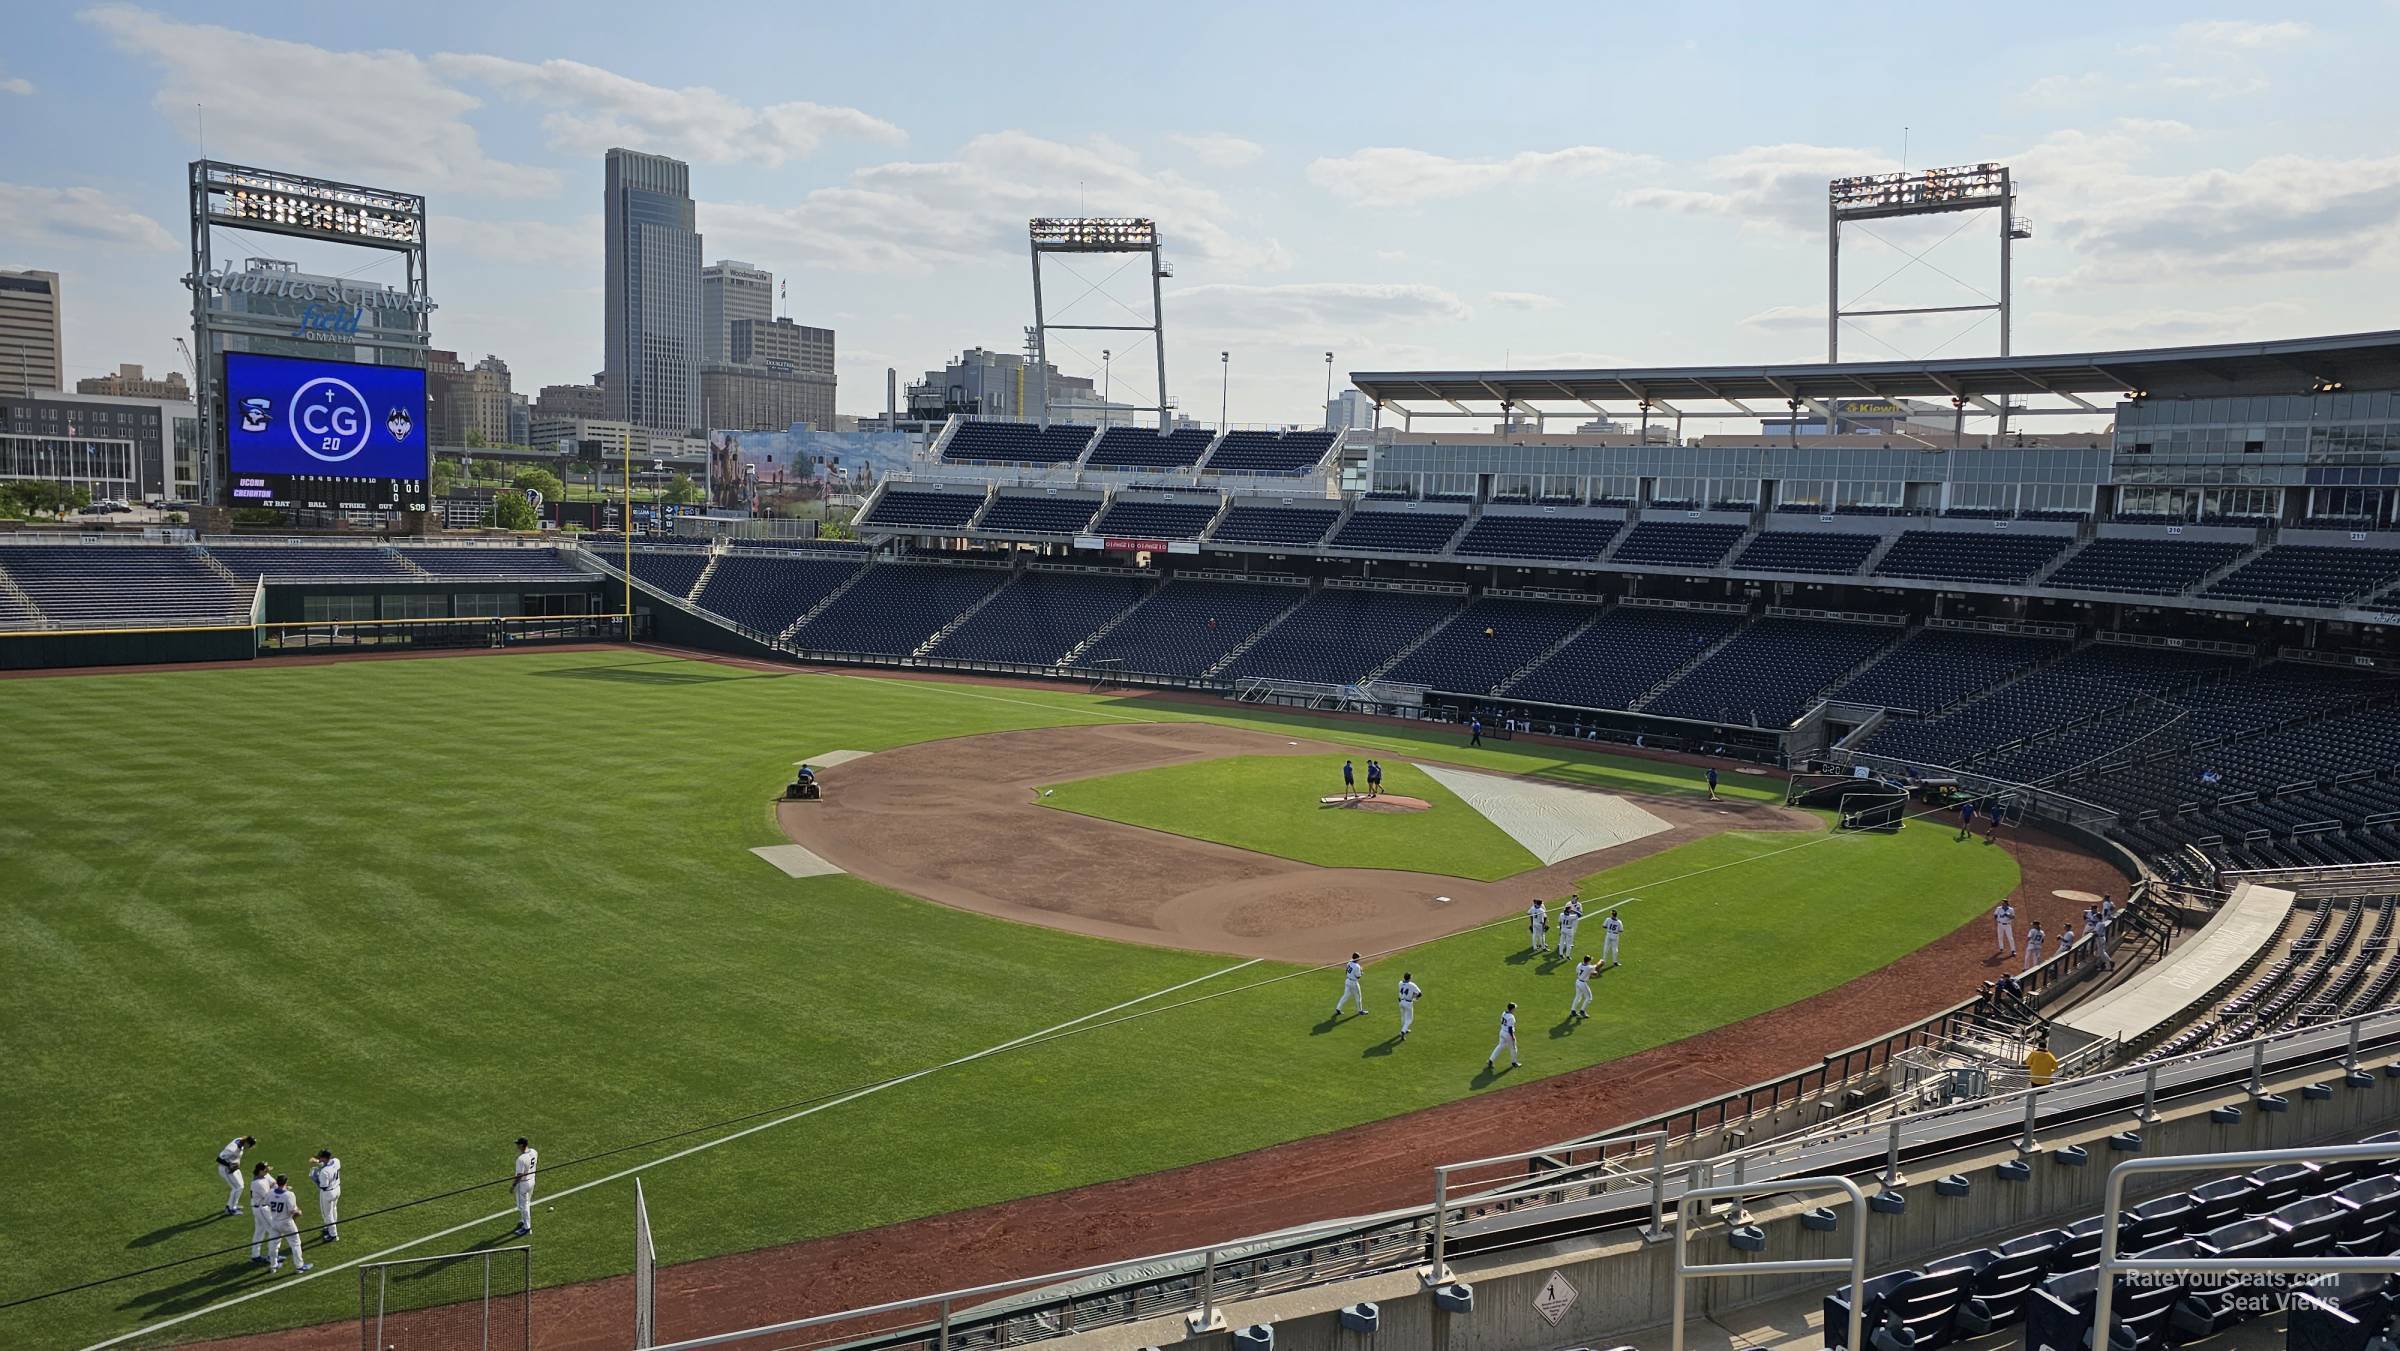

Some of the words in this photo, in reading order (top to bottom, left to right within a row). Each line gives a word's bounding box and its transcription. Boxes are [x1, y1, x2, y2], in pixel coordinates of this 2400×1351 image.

[202, 259, 317, 302] charles
[327, 284, 436, 314] SCHWAB
[292, 303, 364, 337] field
[305, 330, 356, 344] OMAHA
[303, 404, 358, 436] CG
[322, 437, 341, 450] 20
[240, 478, 265, 487] UCONN
[233, 489, 272, 498] CREIGHTON
[1822, 763, 1841, 775] 0:20
[1609, 923, 1617, 931] 15
[1400, 987, 1410, 997] 44
[529, 1157, 536, 1170] 5
[270, 1201, 285, 1213] 20
